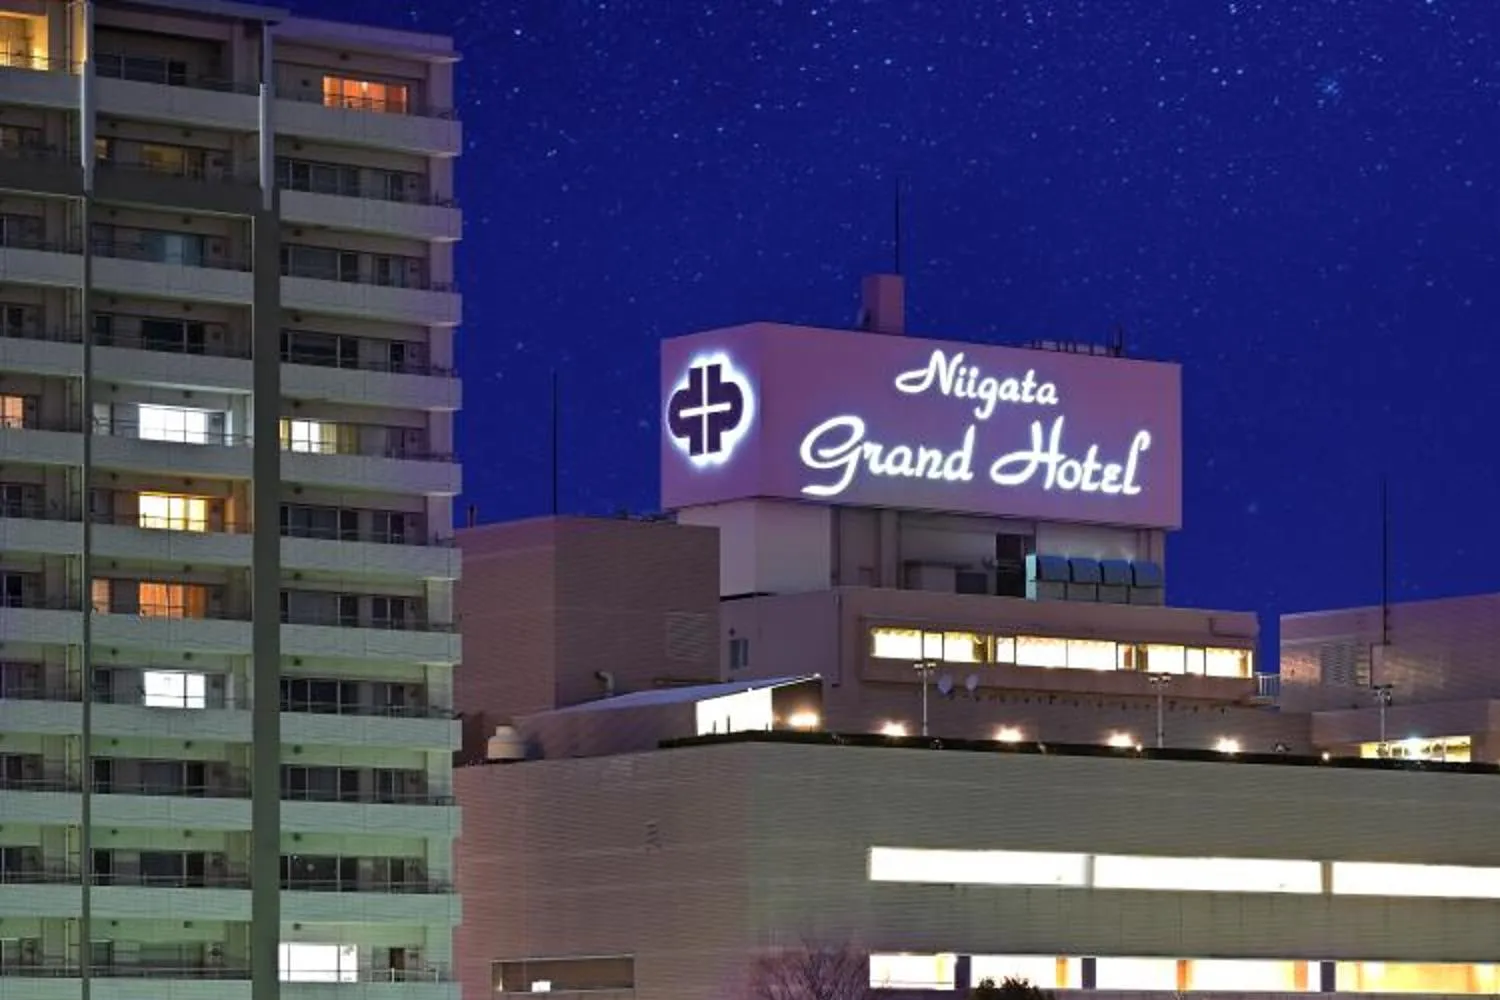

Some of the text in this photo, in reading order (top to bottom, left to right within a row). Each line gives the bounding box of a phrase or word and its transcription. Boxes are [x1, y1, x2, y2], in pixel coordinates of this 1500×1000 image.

[895, 349, 1059, 420] Niigata
[799, 415, 1151, 495] Grand Hotel
